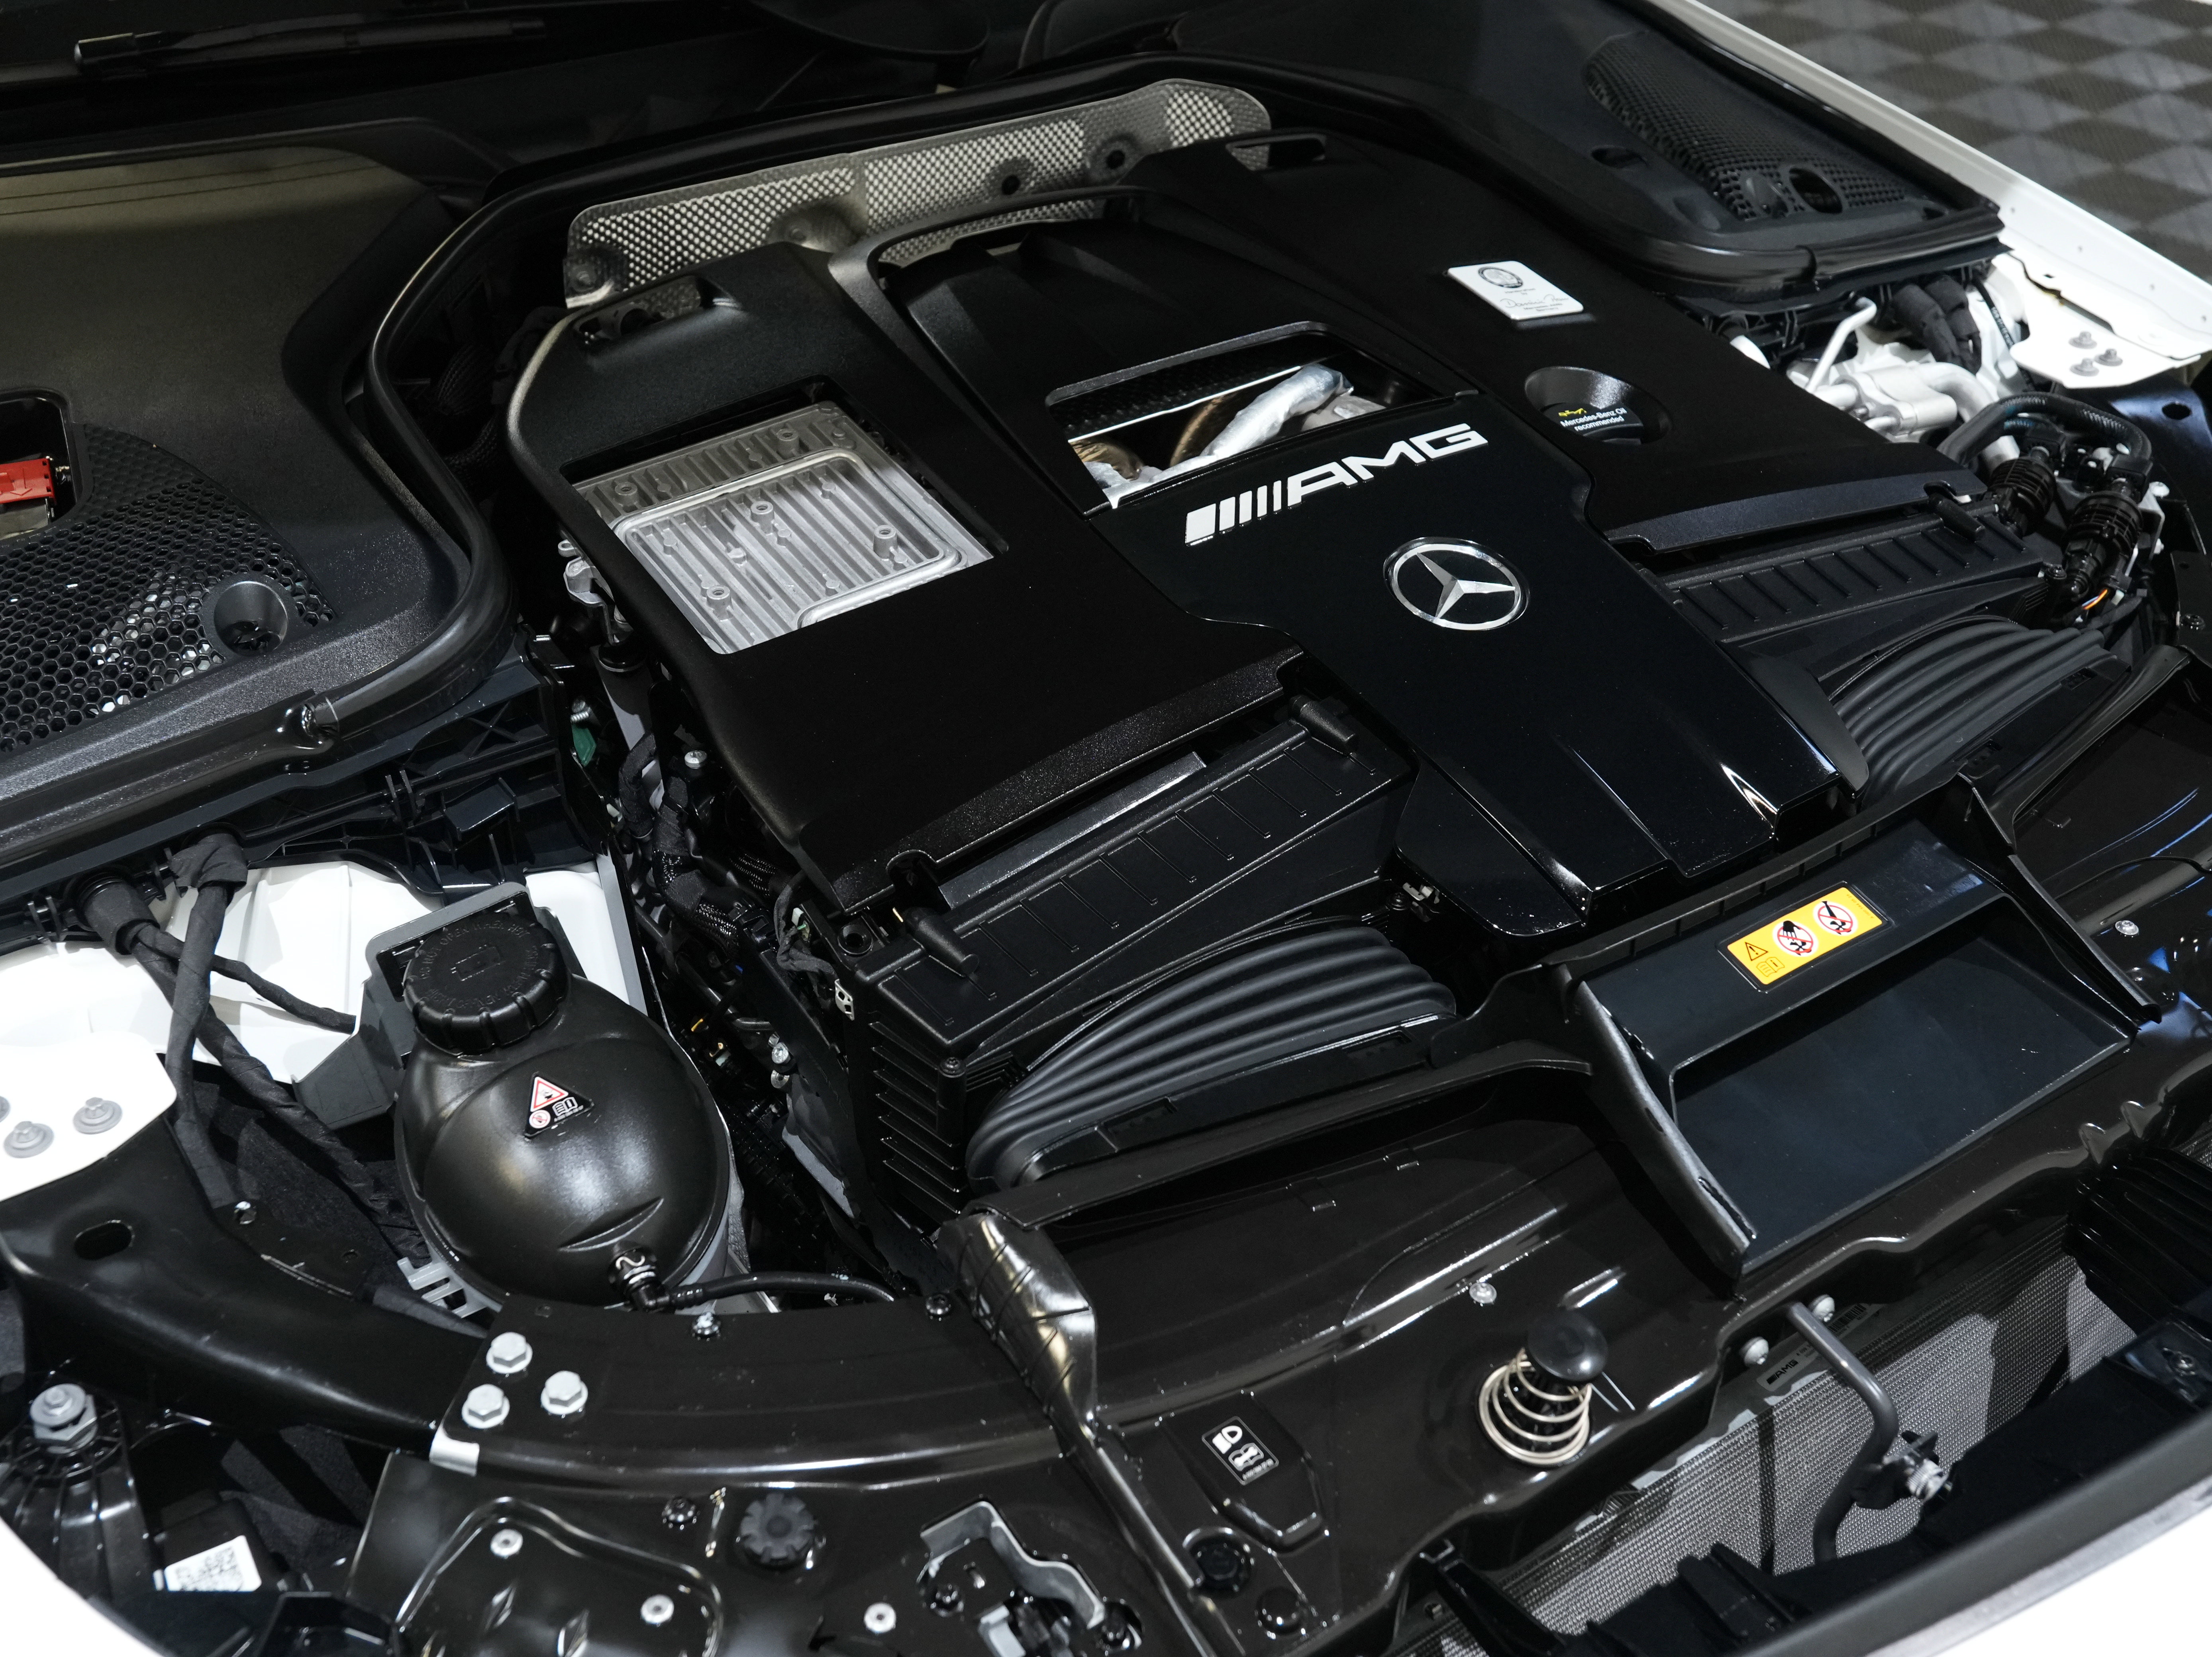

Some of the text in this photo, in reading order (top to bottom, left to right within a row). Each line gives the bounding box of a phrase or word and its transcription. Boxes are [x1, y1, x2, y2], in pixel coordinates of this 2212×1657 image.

[1560, 410, 1616, 427] Mercedes-Benz
[1574, 415, 1625, 431] recommended
[1287, 423, 1488, 507] AMG
[1775, 1359, 1799, 1378] AMG
